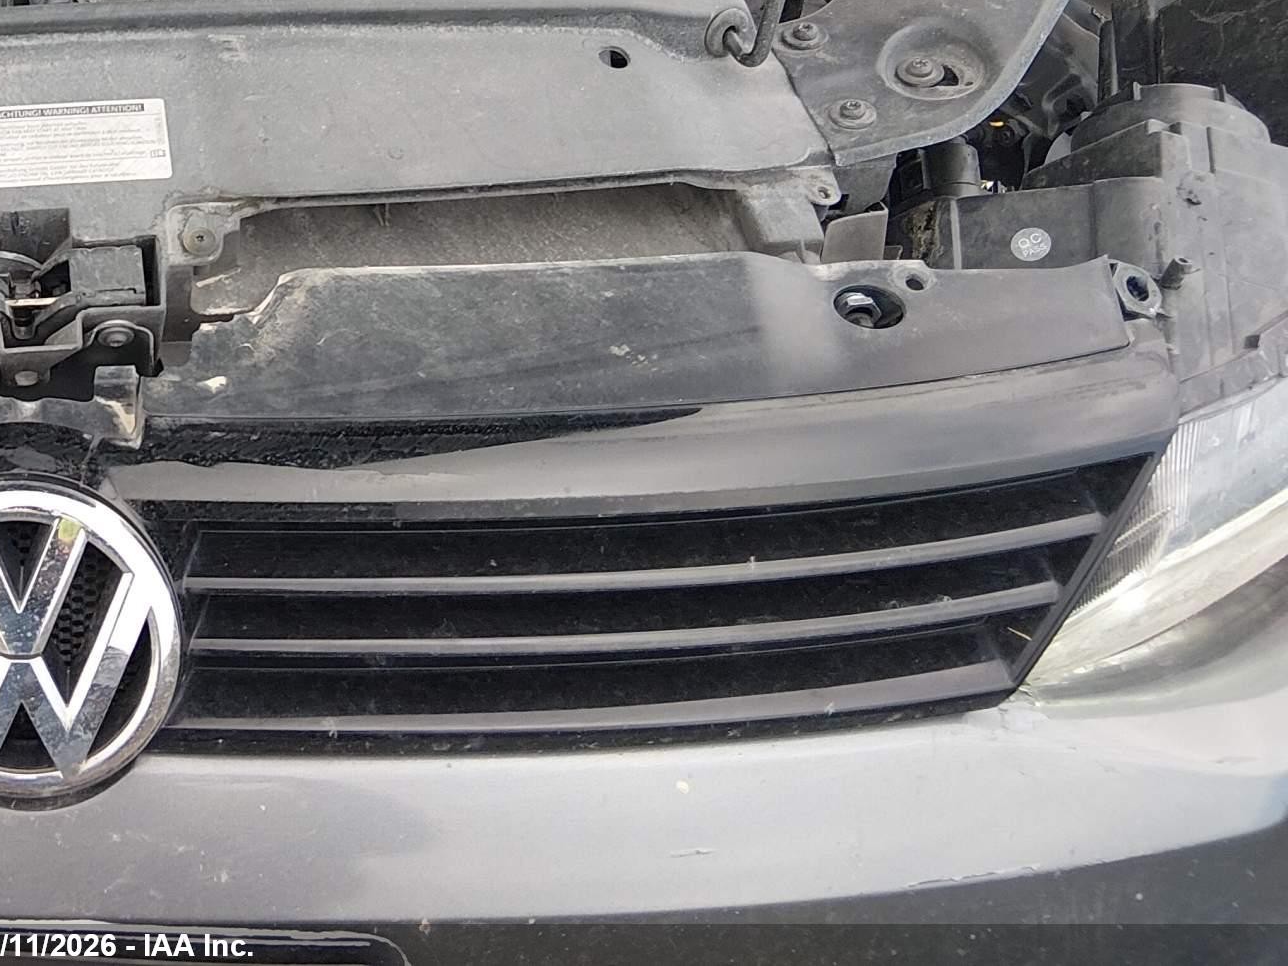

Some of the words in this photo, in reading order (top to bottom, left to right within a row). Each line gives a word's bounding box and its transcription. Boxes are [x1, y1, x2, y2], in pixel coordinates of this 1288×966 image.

[42, 106, 90, 118] WARNING!
[91, 103, 142, 114] ATTENTION!
[1018, 233, 1042, 248] QC
